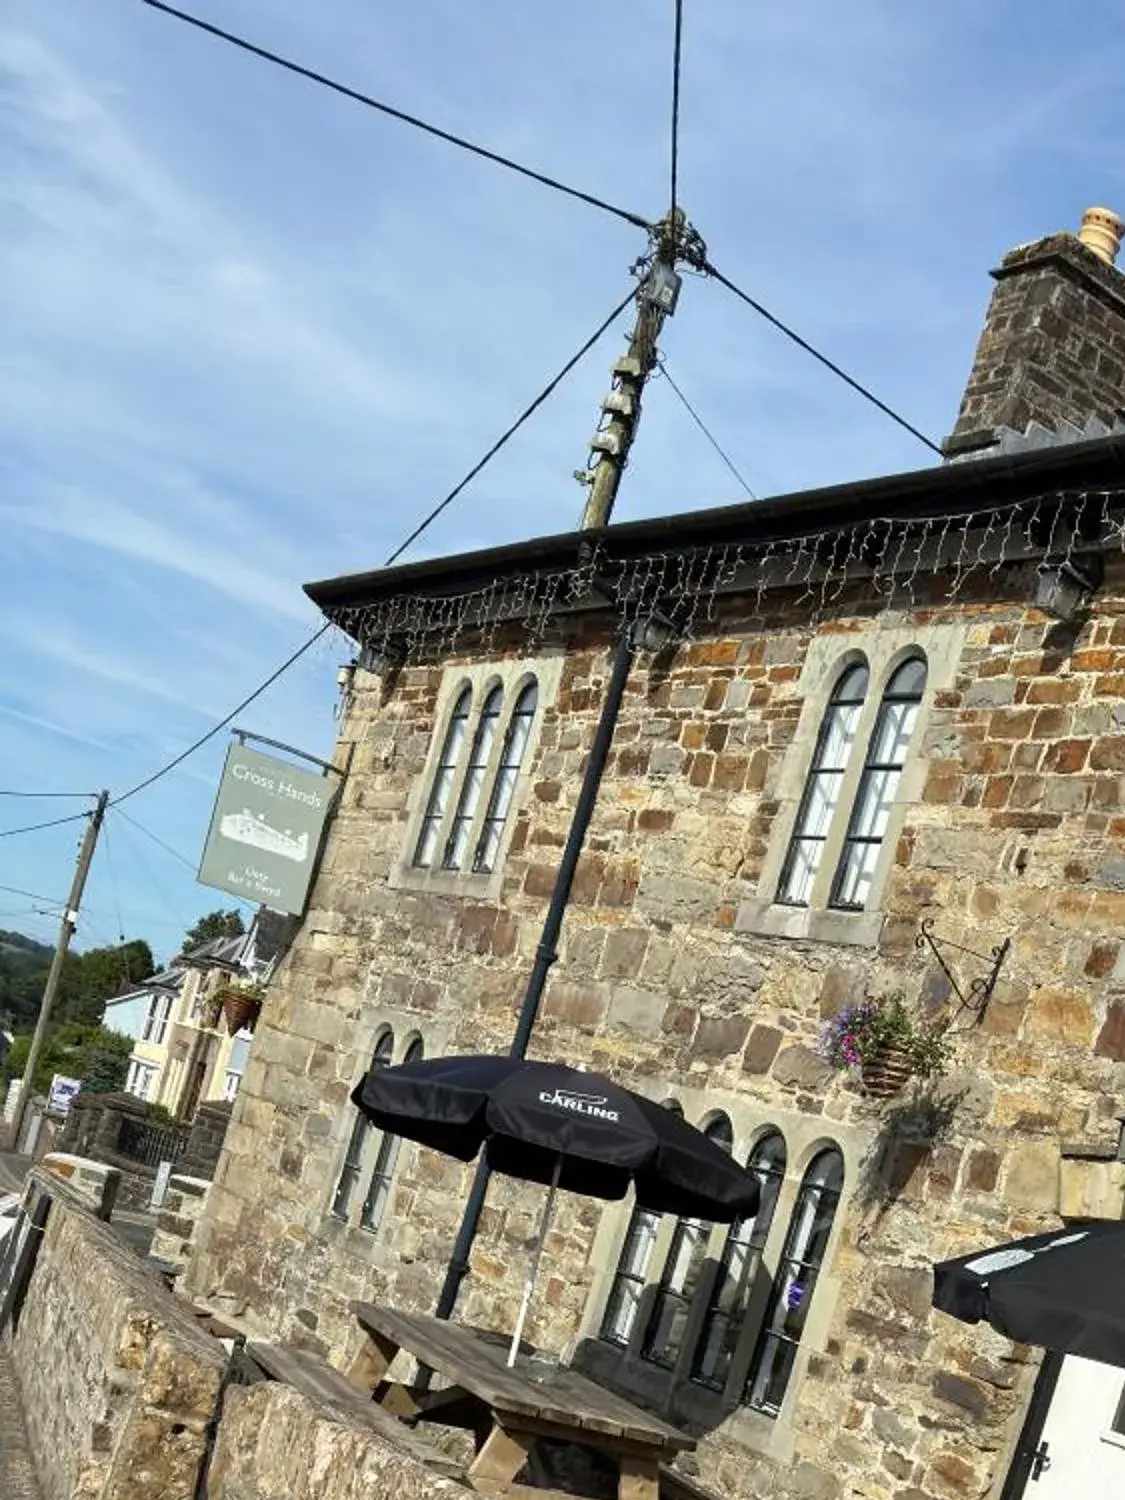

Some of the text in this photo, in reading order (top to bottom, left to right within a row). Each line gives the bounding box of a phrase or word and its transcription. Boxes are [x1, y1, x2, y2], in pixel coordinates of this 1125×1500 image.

[232, 764, 322, 808] Cross Hands
[539, 1091, 619, 1122] CARLING
